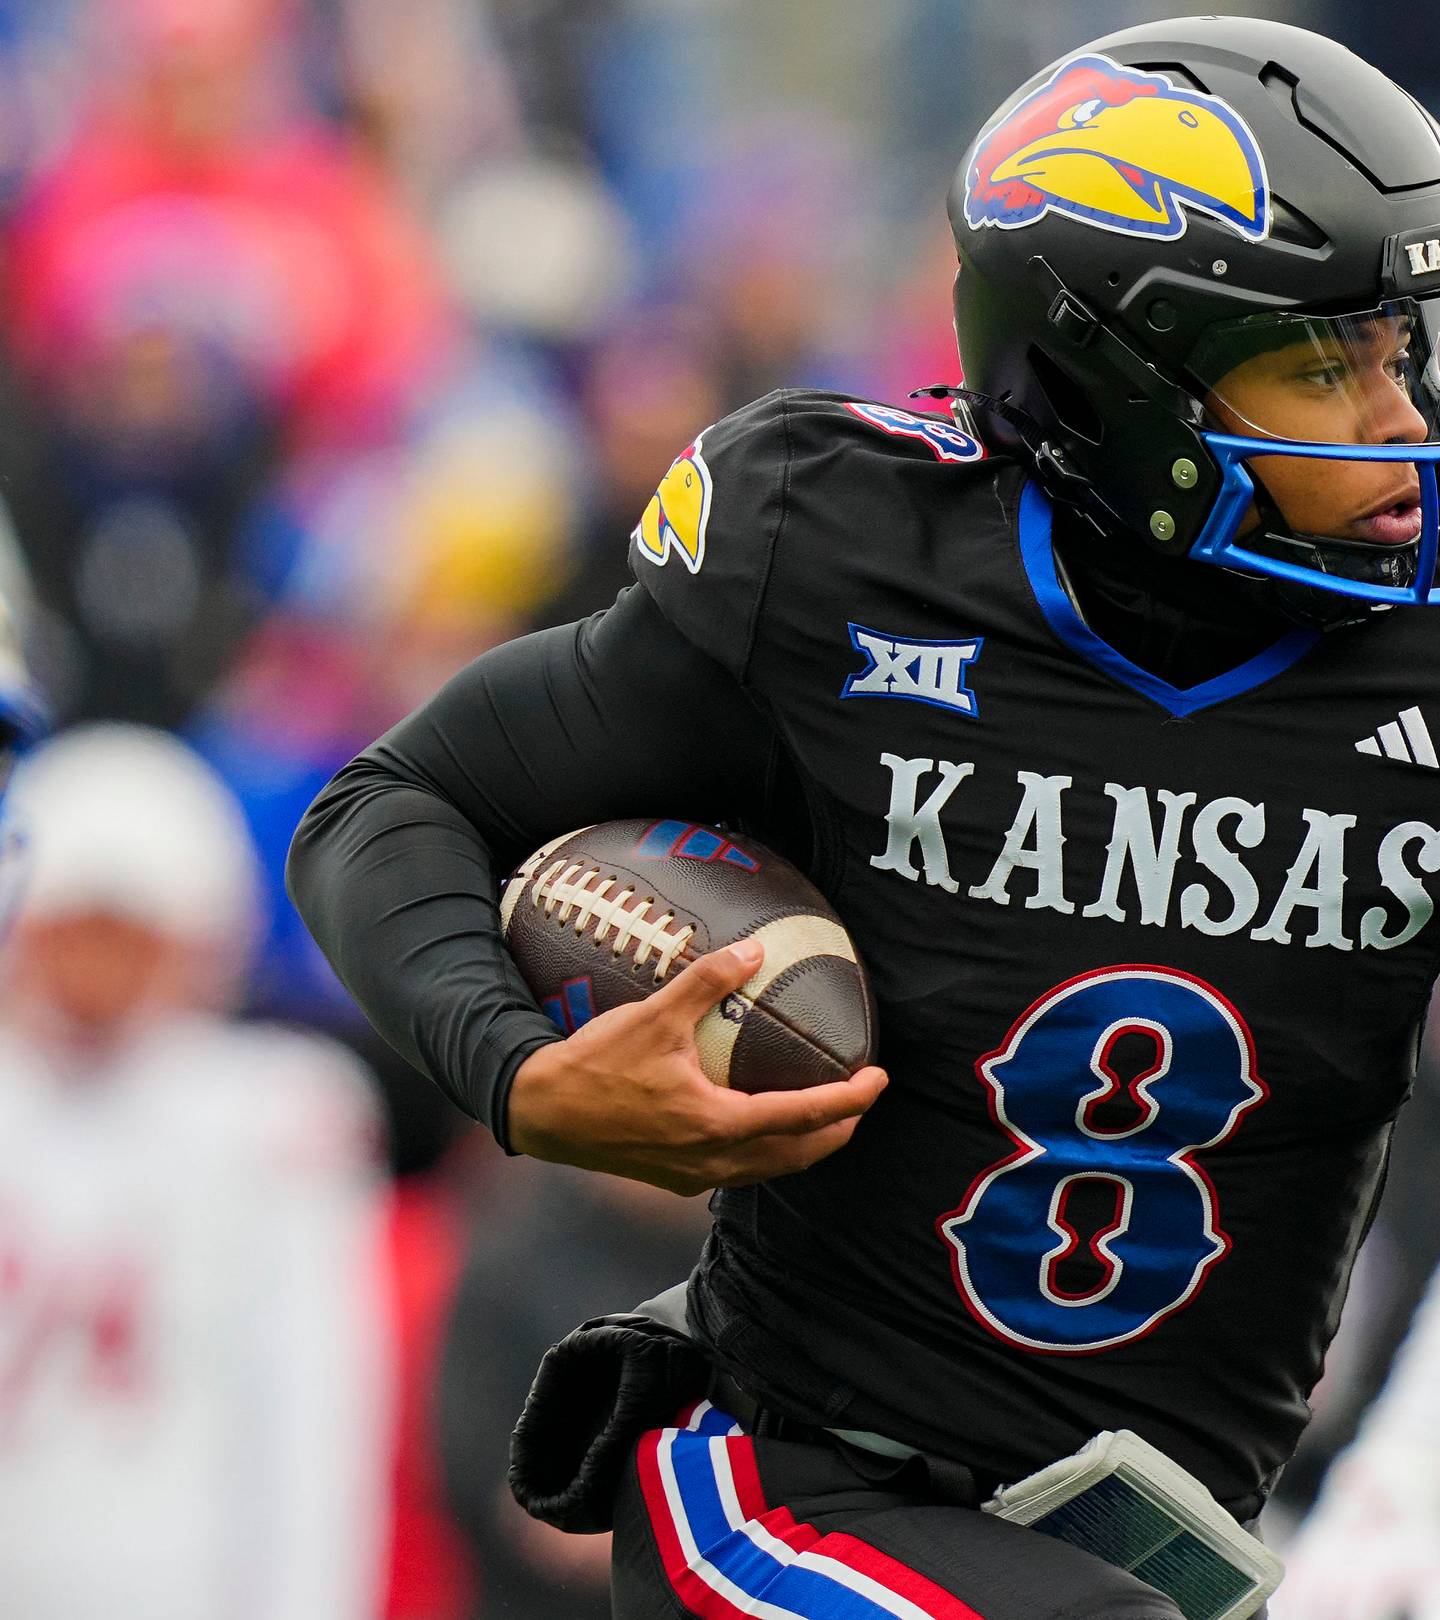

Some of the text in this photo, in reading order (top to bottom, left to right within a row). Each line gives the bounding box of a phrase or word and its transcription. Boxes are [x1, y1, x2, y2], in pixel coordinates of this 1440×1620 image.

[844, 402, 988, 463] 8
[848, 630, 978, 713] XII
[936, 963, 1270, 1357] 8
